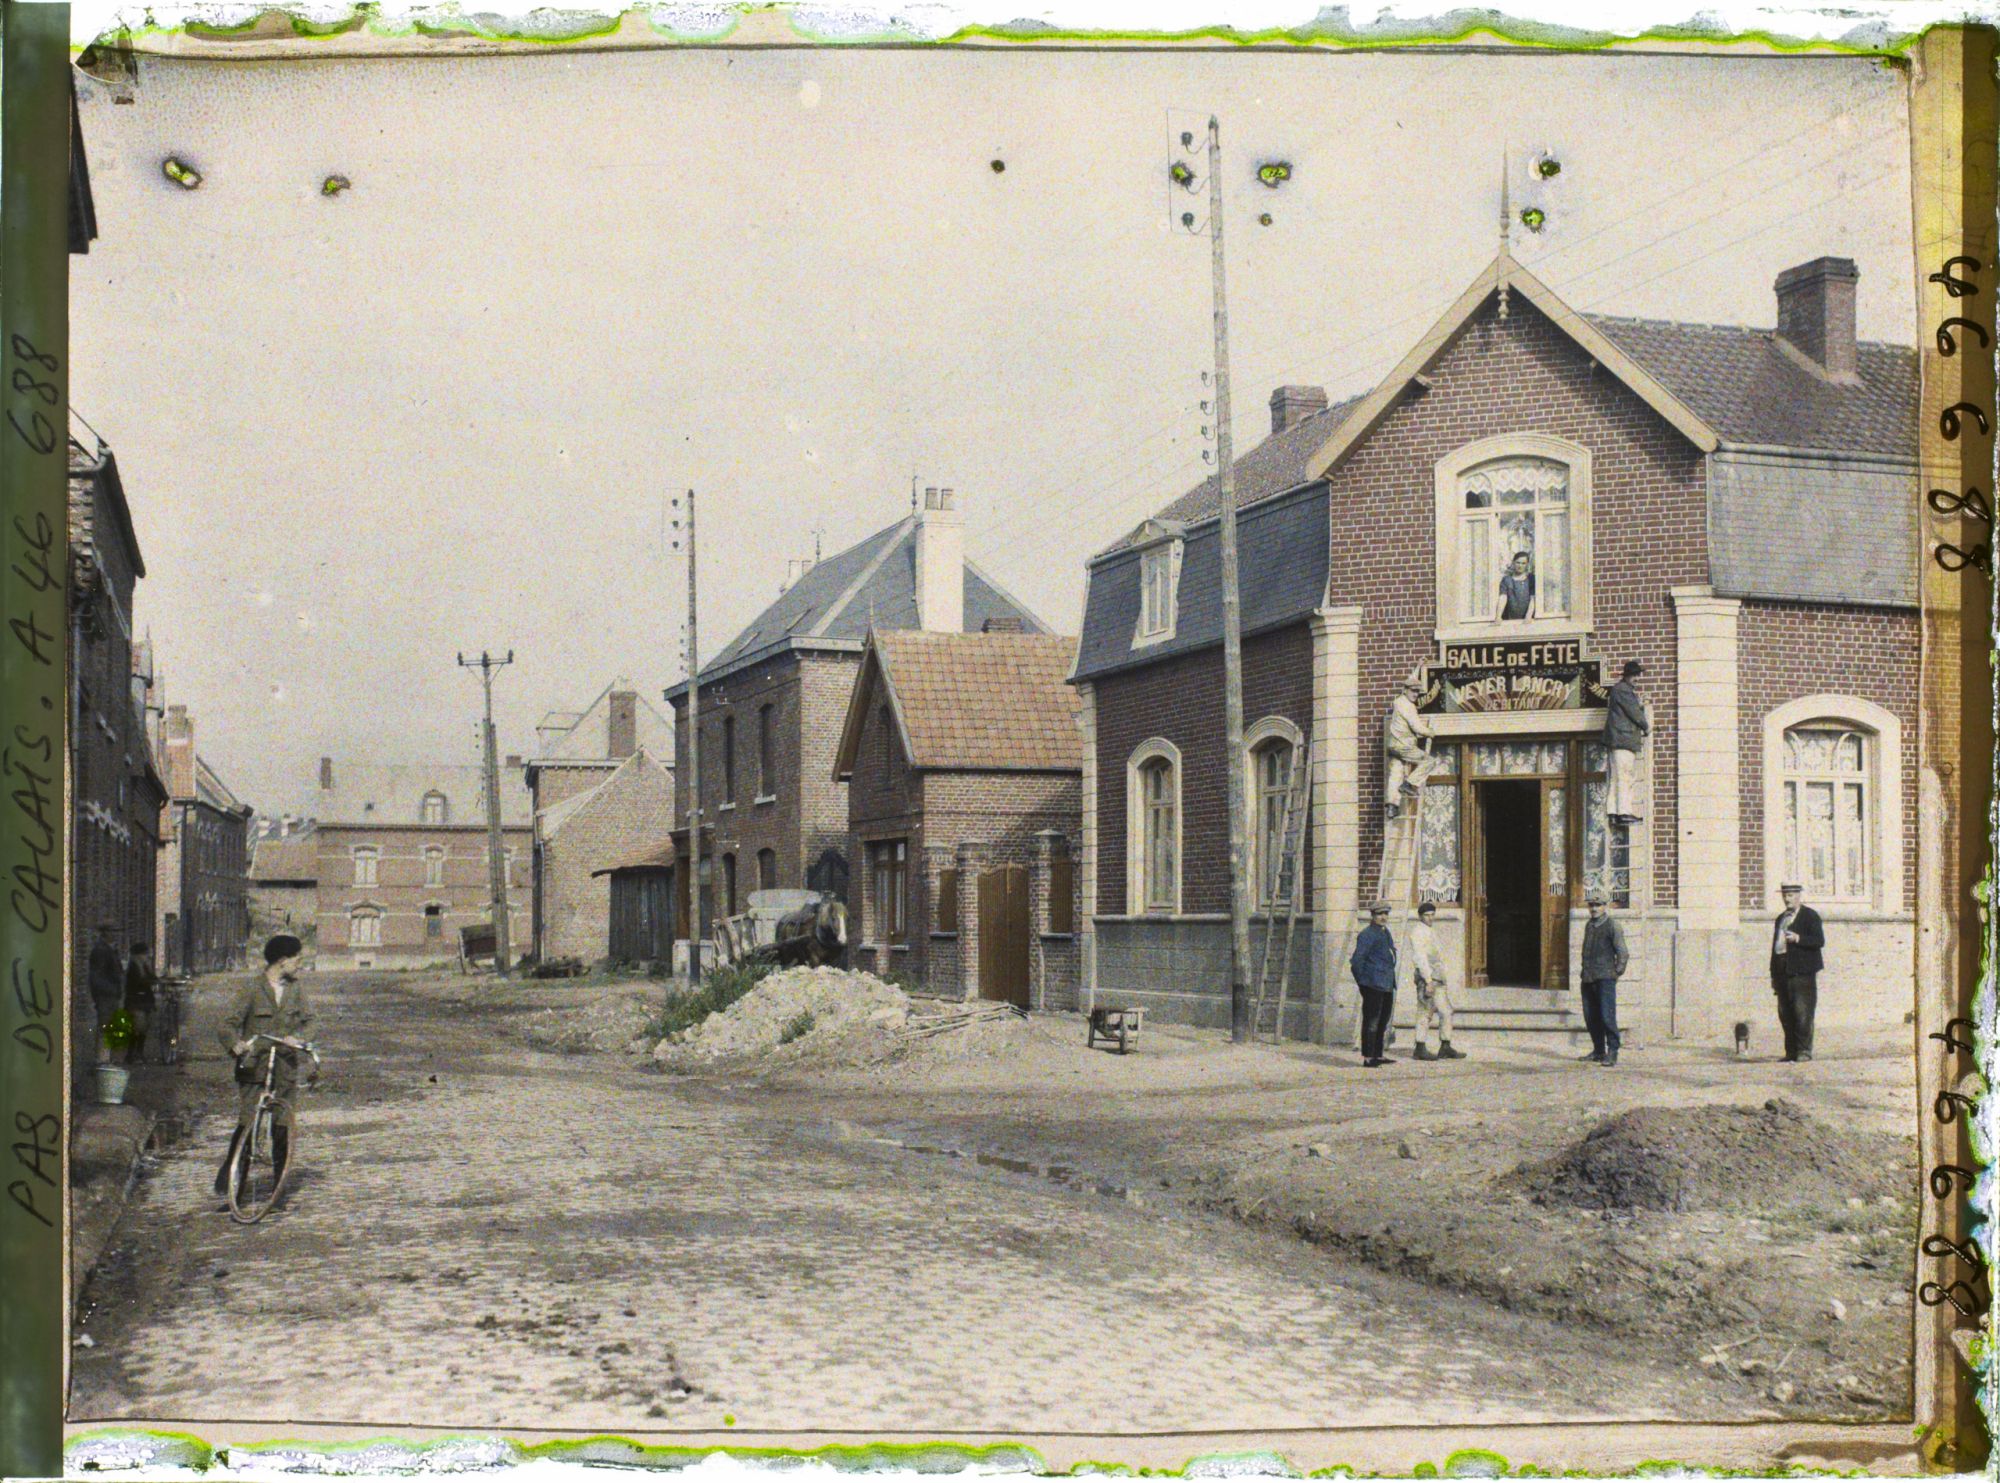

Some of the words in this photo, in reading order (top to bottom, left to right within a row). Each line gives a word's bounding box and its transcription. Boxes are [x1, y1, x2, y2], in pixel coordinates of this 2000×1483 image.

[9, 610, 53, 667] A
[1447, 646, 1505, 669] SALLE
[1507, 652, 1528, 667] DE
[1531, 641, 1578, 665] FÊTE
[12, 957, 53, 1064] DE
[7, 1110, 61, 1228] PAS
